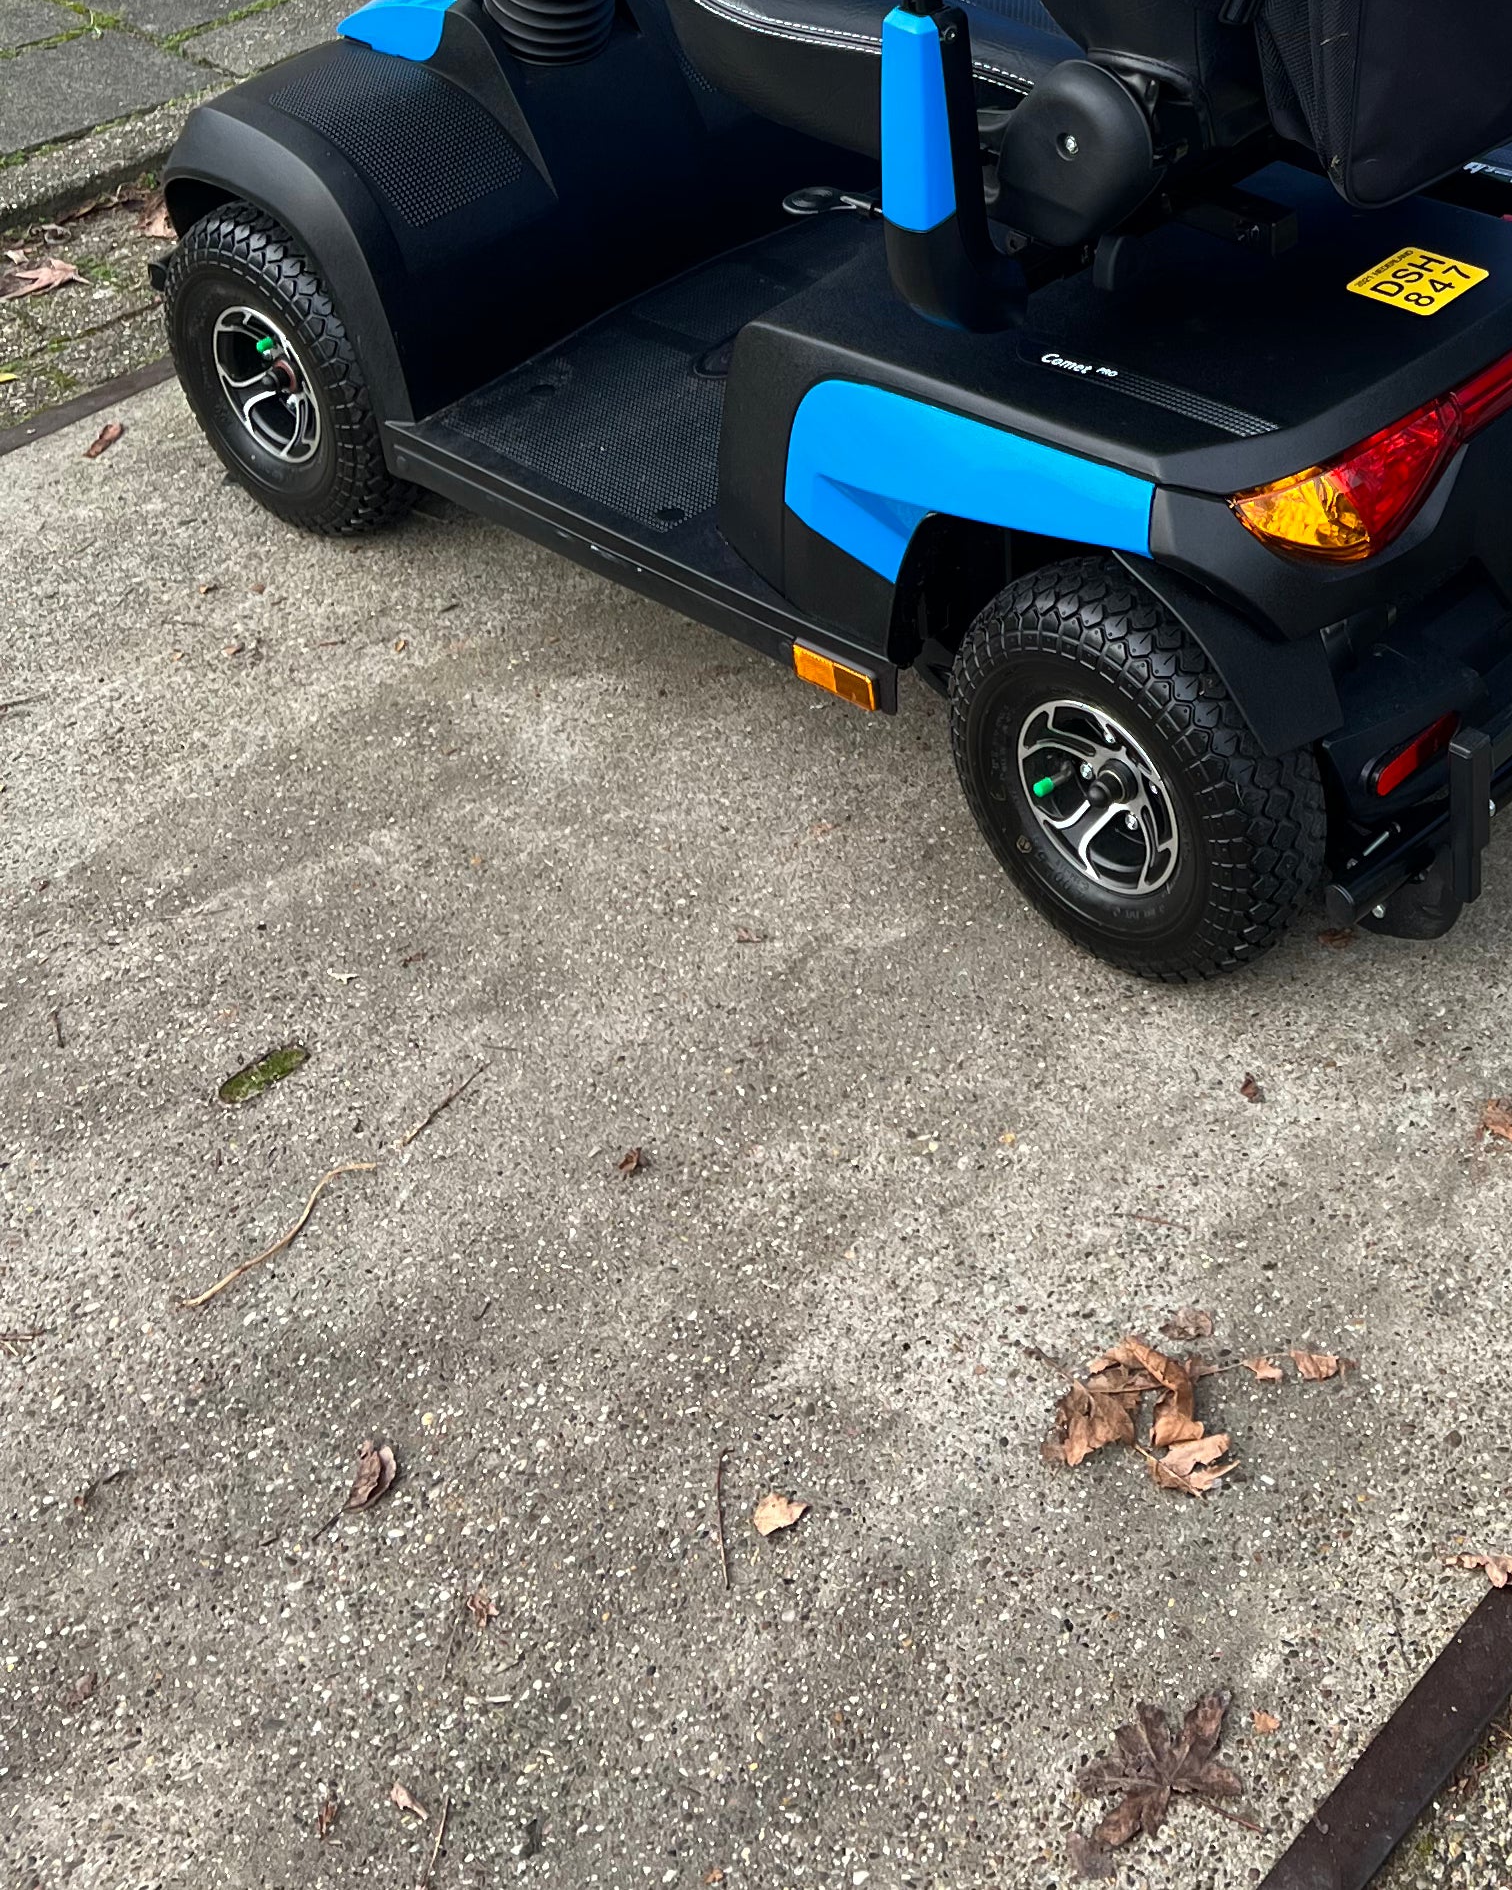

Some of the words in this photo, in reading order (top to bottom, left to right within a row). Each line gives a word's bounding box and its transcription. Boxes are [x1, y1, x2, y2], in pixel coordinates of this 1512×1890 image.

[1370, 255, 1446, 297] DSH
[1372, 250, 1414, 277] NEDERLAND
[1404, 265, 1471, 307] 847
[1041, 353, 1093, 374] Comet
